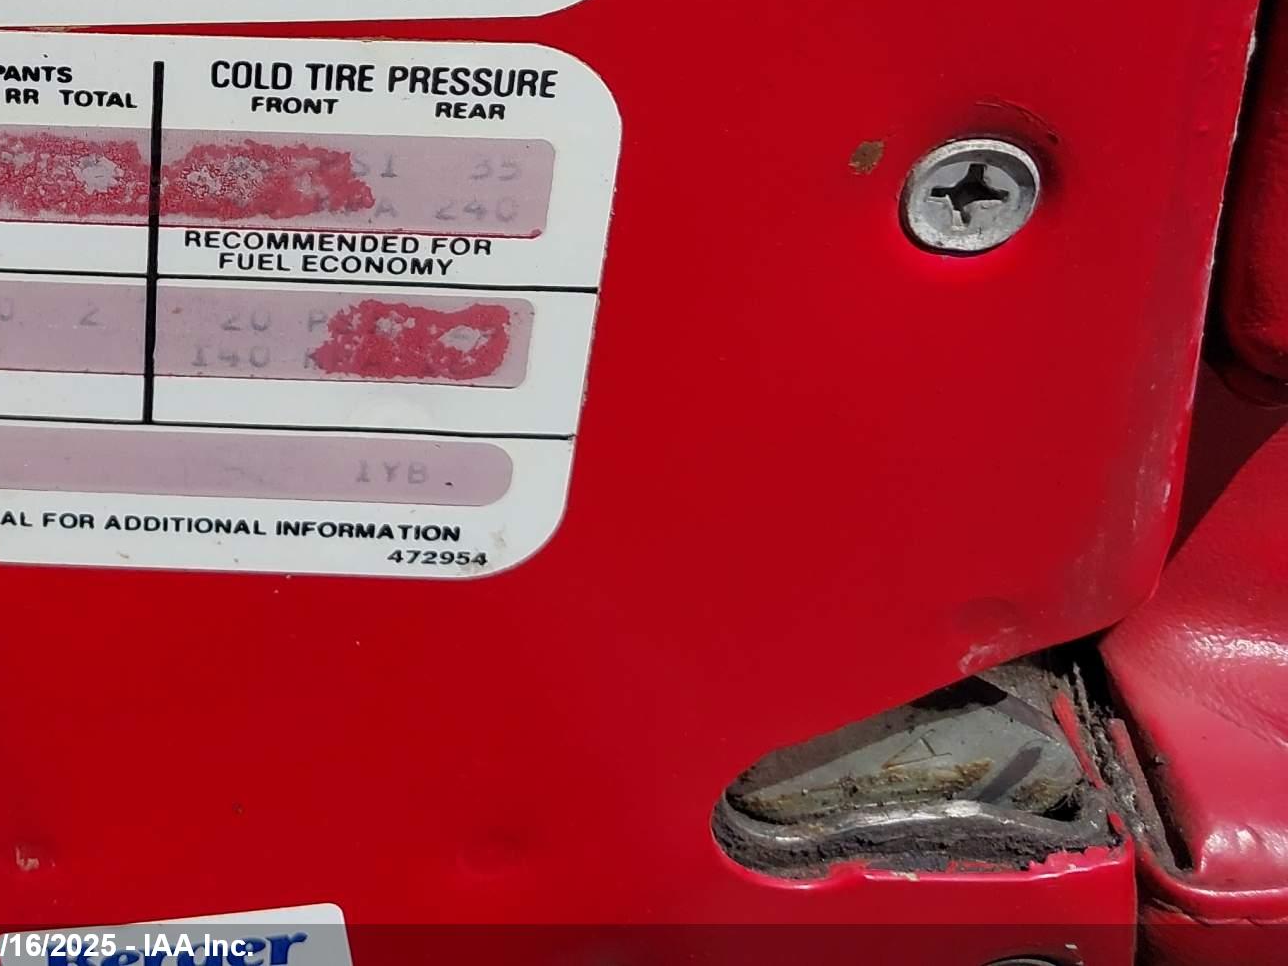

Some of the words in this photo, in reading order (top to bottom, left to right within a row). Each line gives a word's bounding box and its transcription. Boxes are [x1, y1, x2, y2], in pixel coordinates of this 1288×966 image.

[212, 60, 294, 93] COLD
[306, 62, 375, 95] TIRE
[388, 64, 559, 100] PRESSURE
[5, 88, 40, 106] RR
[60, 89, 139, 110] TOTAL
[251, 96, 339, 116] FRONT
[435, 100, 506, 121] REAR
[185, 231, 419, 256] RECOMMENDED
[432, 236, 492, 257] FOR
[219, 252, 291, 272] FUEL
[302, 253, 454, 277] ECONOMY
[43, 512, 95, 531] FOR
[104, 514, 267, 537] ADDITIONAL
[275, 521, 461, 542] INFORMATION
[388, 550, 488, 567] 472954
